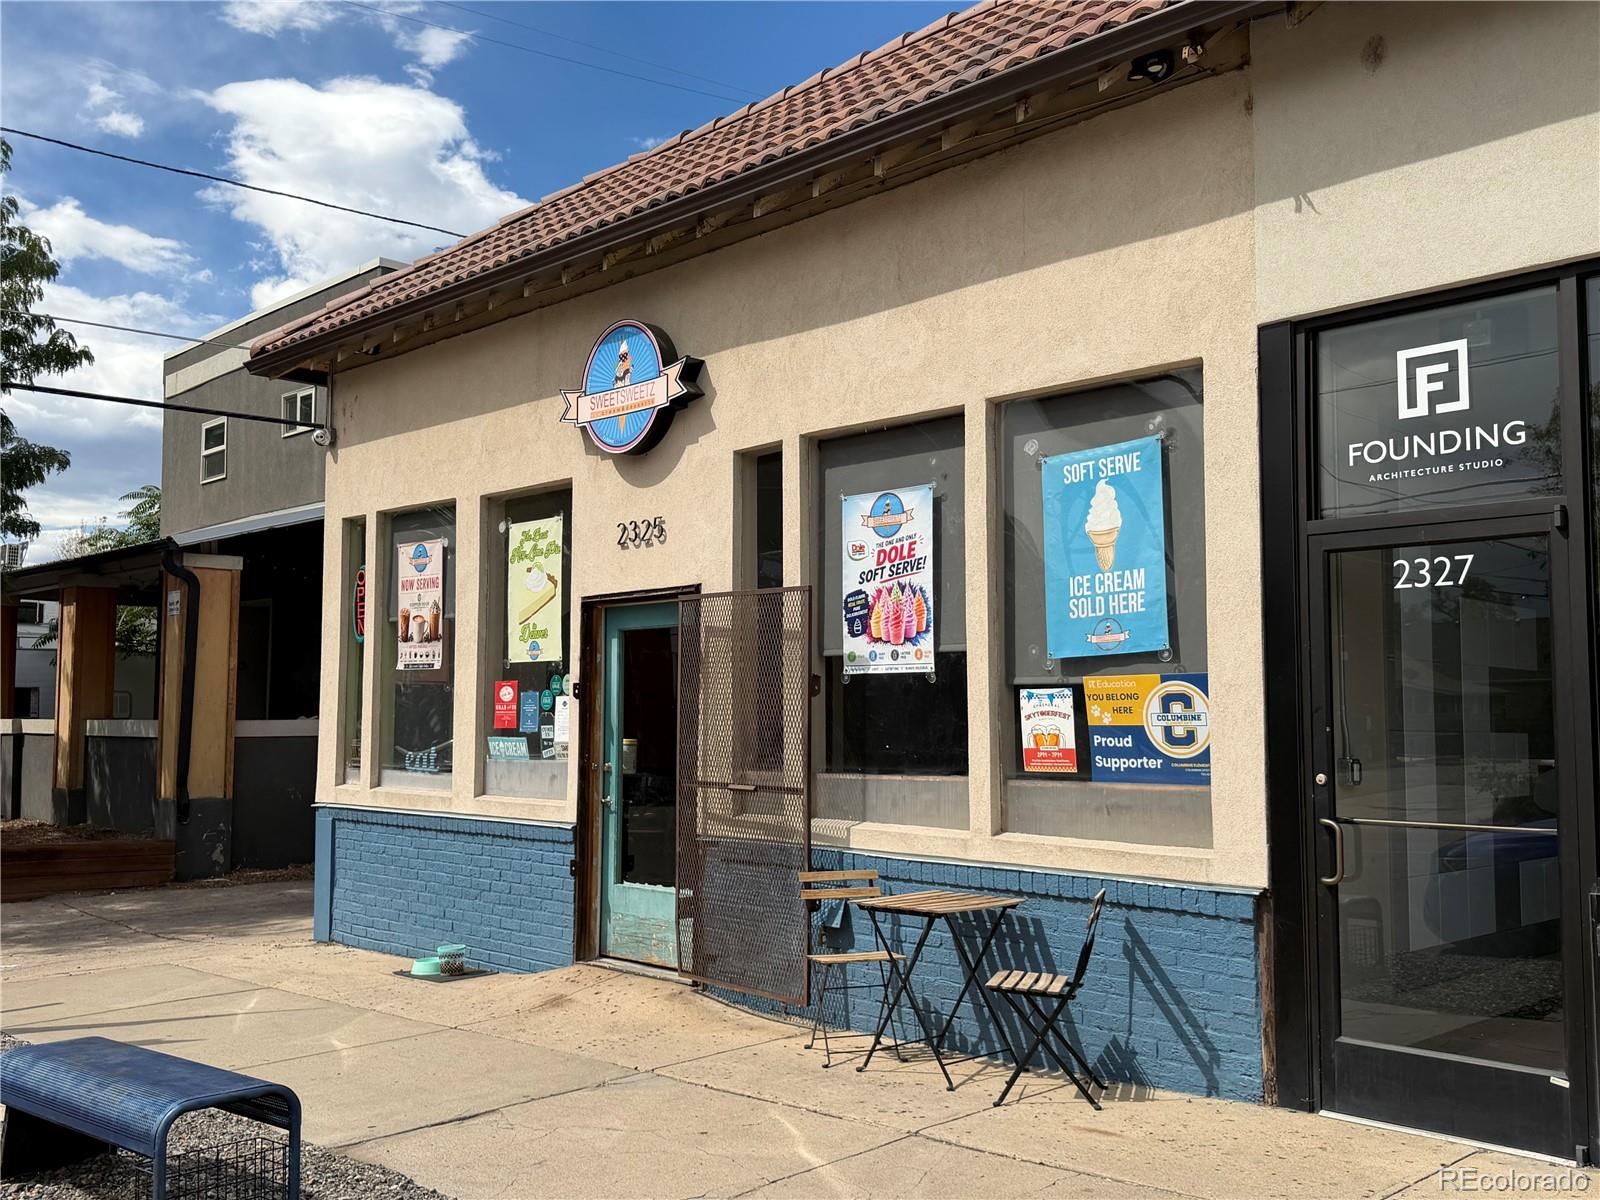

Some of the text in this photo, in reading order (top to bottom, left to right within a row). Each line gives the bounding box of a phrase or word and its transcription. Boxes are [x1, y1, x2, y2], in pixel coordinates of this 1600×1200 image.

[590, 381, 656, 411] SWEETSWEETZ
[1348, 420, 1526, 466] FOUNDING
[1063, 452, 1142, 484] SOFT SERVE
[1368, 458, 1503, 482] ARCHITECTURE STUDIO
[616, 516, 664, 546] 2325
[885, 539, 894, 547] ONE
[895, 536, 905, 544] AND
[905, 533, 917, 541] ONLY
[876, 540, 917, 567] DOLE
[858, 555, 927, 585] SOFT SERVE!
[1069, 567, 1145, 597] ICE CREAM
[1393, 554, 1474, 589] 2327
[401, 577, 440, 592] NOW SERVING
[357, 570, 365, 635] OPEN
[1069, 591, 1146, 619] SOLD HERE
[1086, 692, 1139, 701] YOU BELONG
[1112, 706, 1133, 714] HERE
[1156, 714, 1202, 722] COLUMBINE
[489, 741, 528, 757] ICE CREAM
[1094, 735, 1132, 747] Proud
[1095, 755, 1163, 772] Supporter
